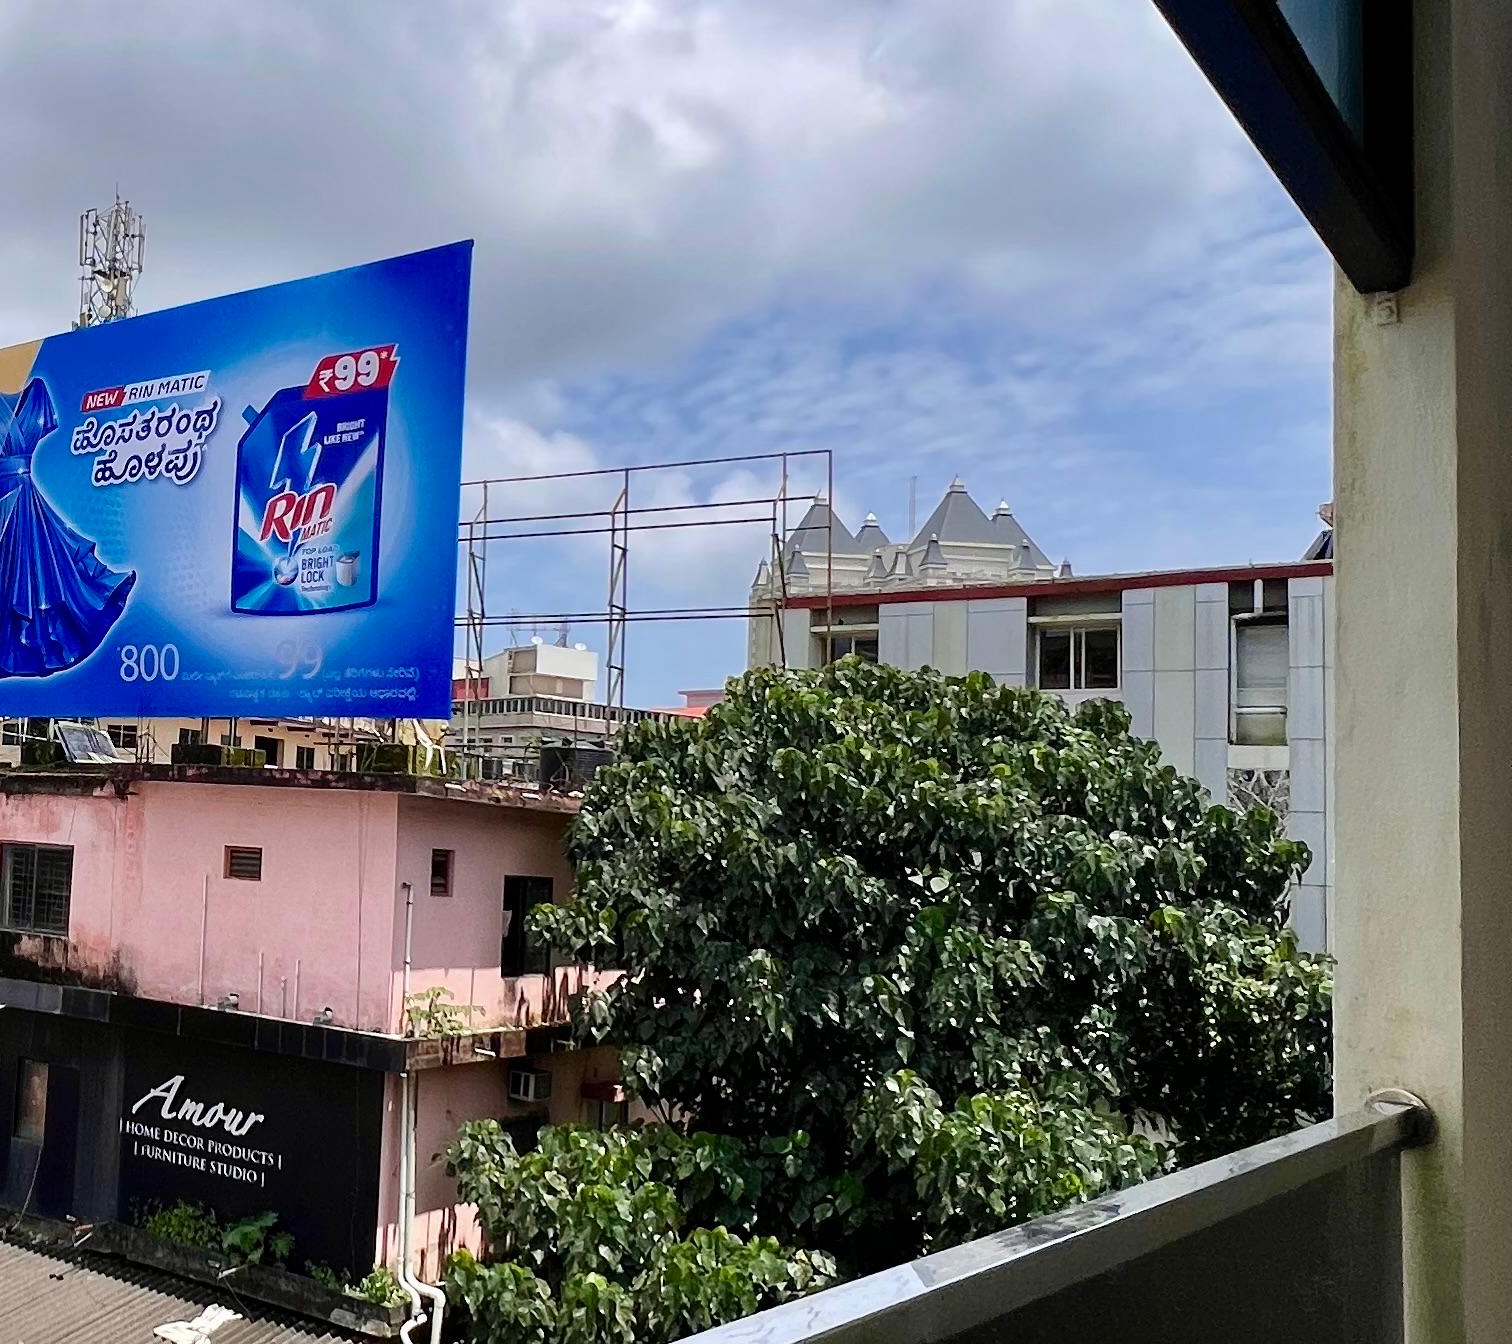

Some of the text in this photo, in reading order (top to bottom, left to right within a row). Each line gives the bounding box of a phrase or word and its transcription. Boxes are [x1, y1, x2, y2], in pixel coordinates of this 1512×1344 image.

[86, 375, 205, 410] NEW RIN MATIC
[73, 399, 219, 451] ಹೊಸತರಂಥ
[94, 439, 198, 482] ಹೊಳಪು
[300, 518, 333, 541] MATIC
[300, 570, 325, 584] LOCK
[301, 555, 334, 571] BRIGHT
[119, 643, 180, 682] 800
[131, 1075, 265, 1136] Amour
[126, 1120, 274, 1166] HOME DECOR PRODUCTS
[141, 1144, 257, 1183] FURNITURE STUDIO
